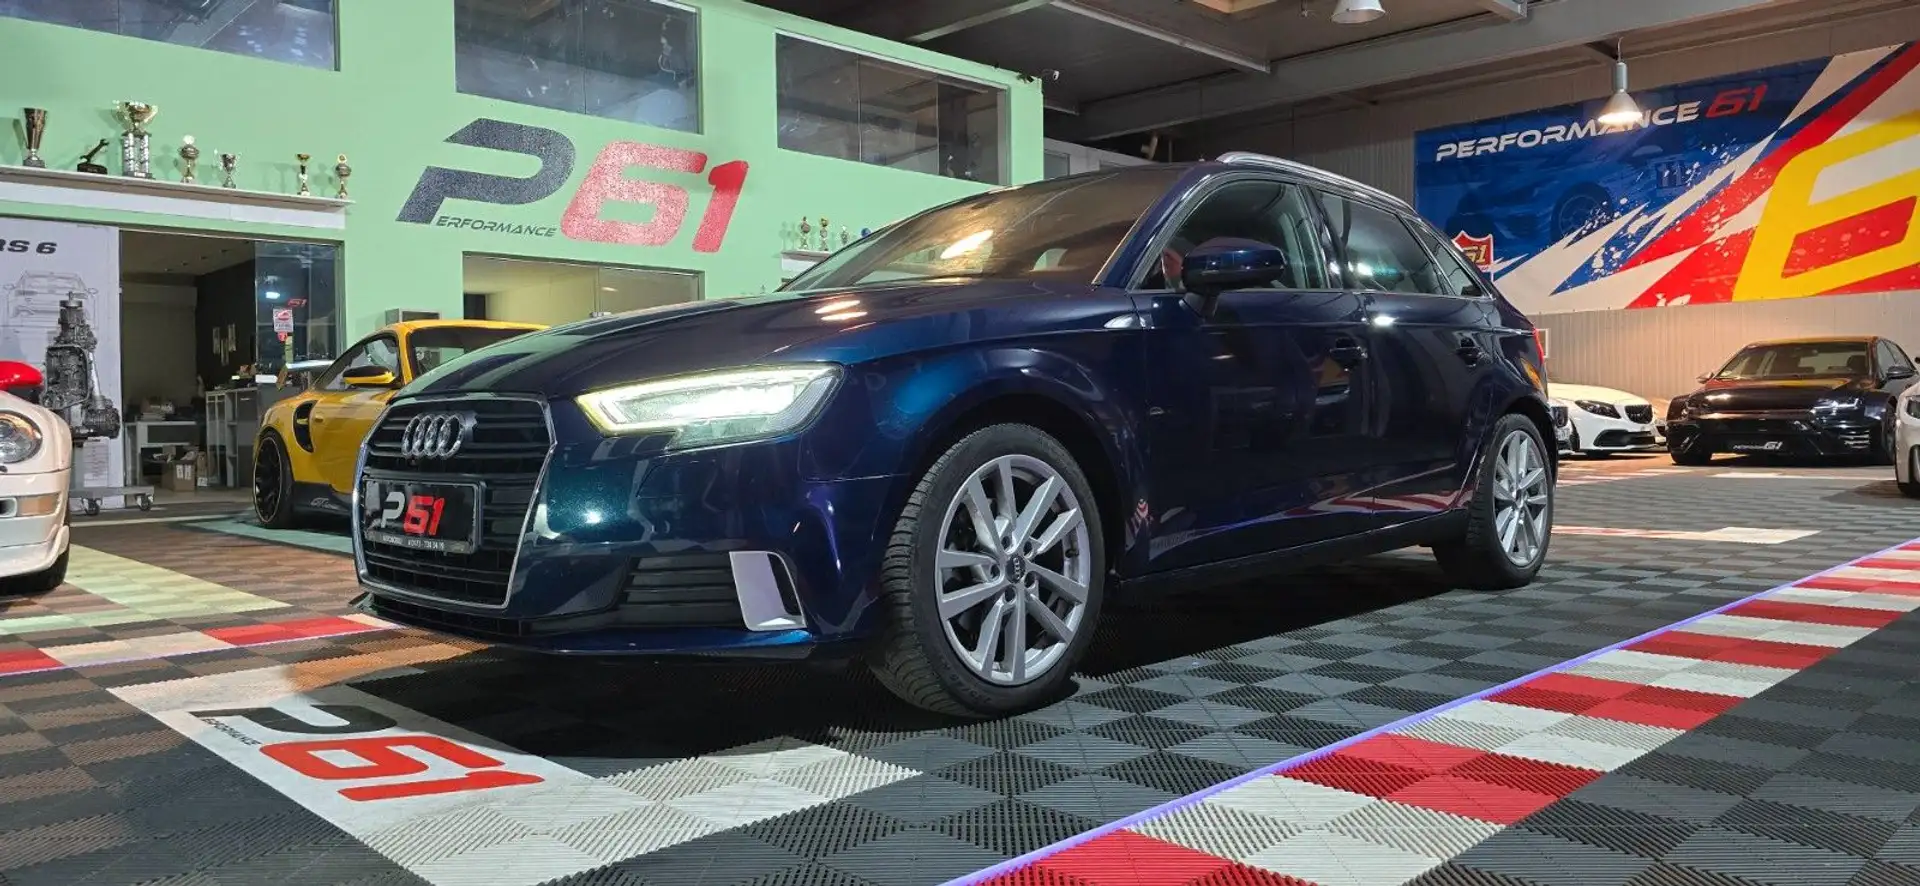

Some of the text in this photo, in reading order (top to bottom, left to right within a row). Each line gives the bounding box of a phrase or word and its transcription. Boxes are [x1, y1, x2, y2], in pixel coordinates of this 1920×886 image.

[1435, 84, 1768, 162] PERFORMANCE 61
[0, 238, 57, 254] S 6
